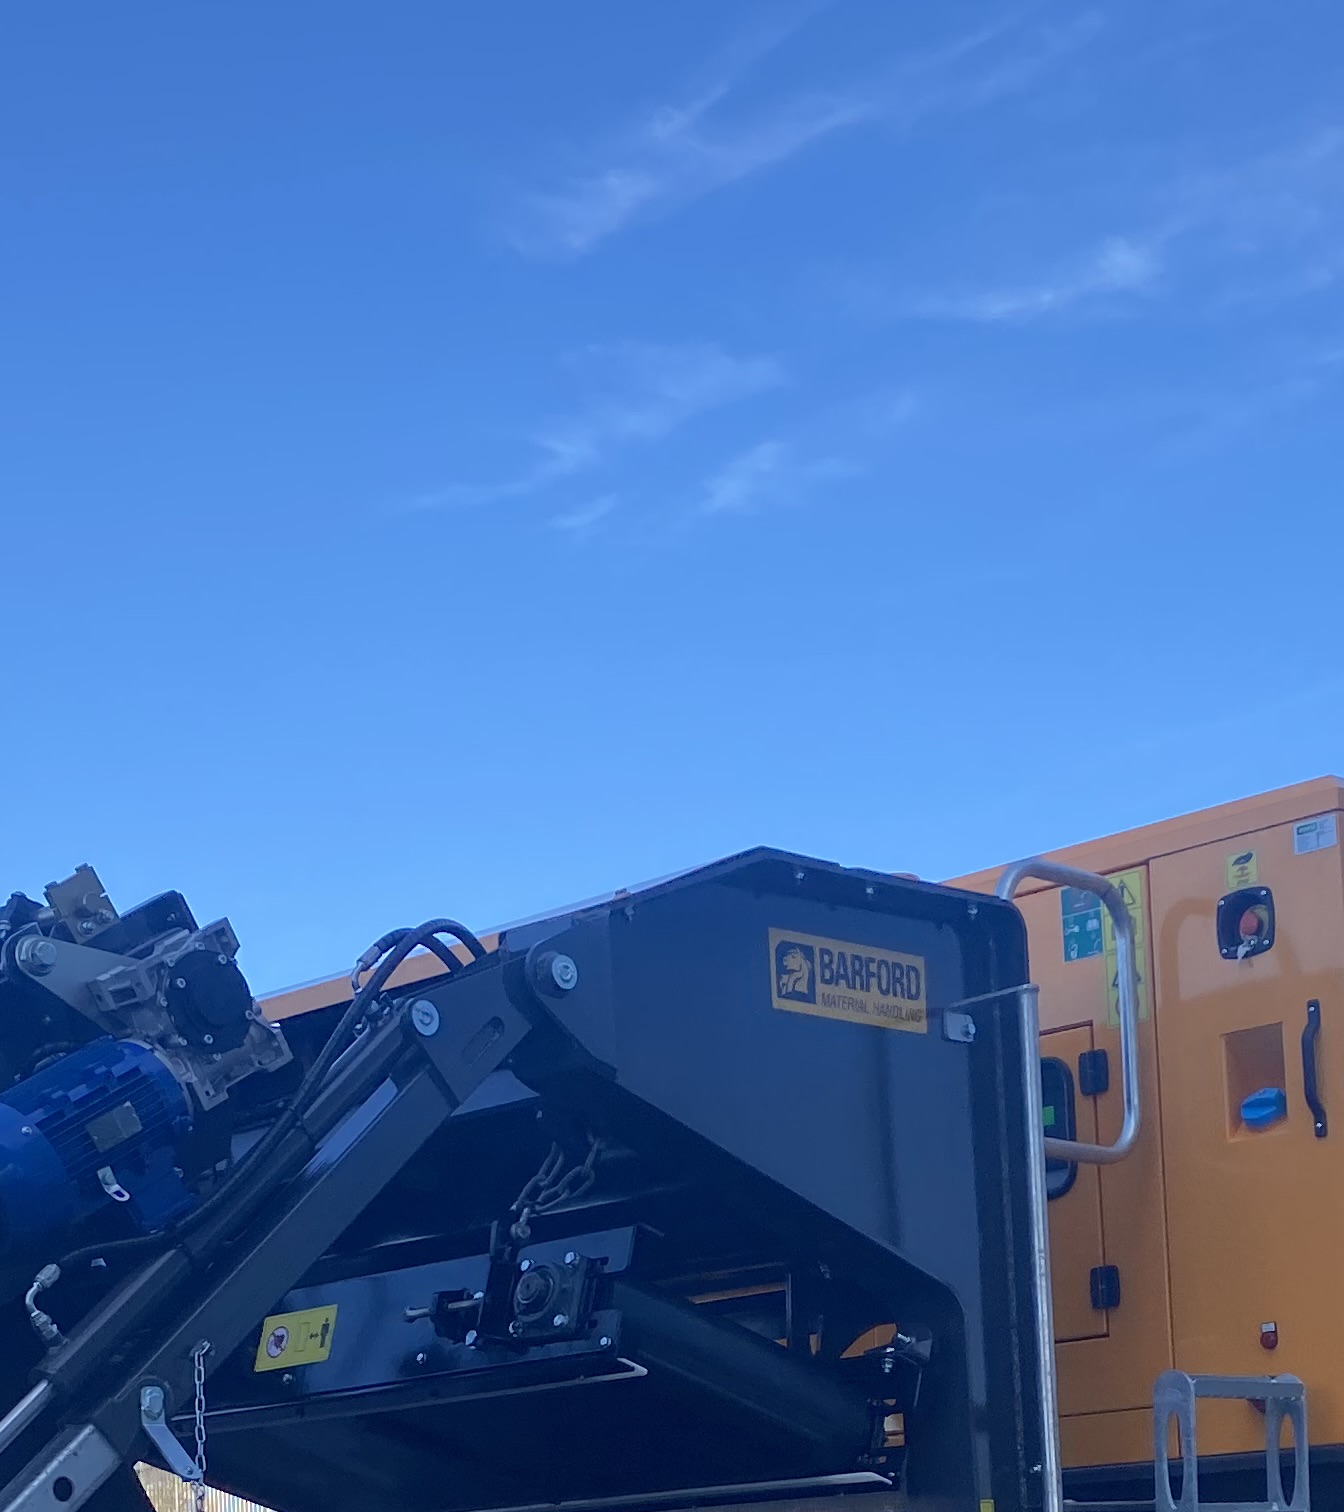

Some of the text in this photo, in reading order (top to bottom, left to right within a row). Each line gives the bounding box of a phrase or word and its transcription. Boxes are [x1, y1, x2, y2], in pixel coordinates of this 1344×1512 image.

[818, 947, 921, 1001] BARFORD
[820, 991, 923, 1023] MATERIAL HANDLING
